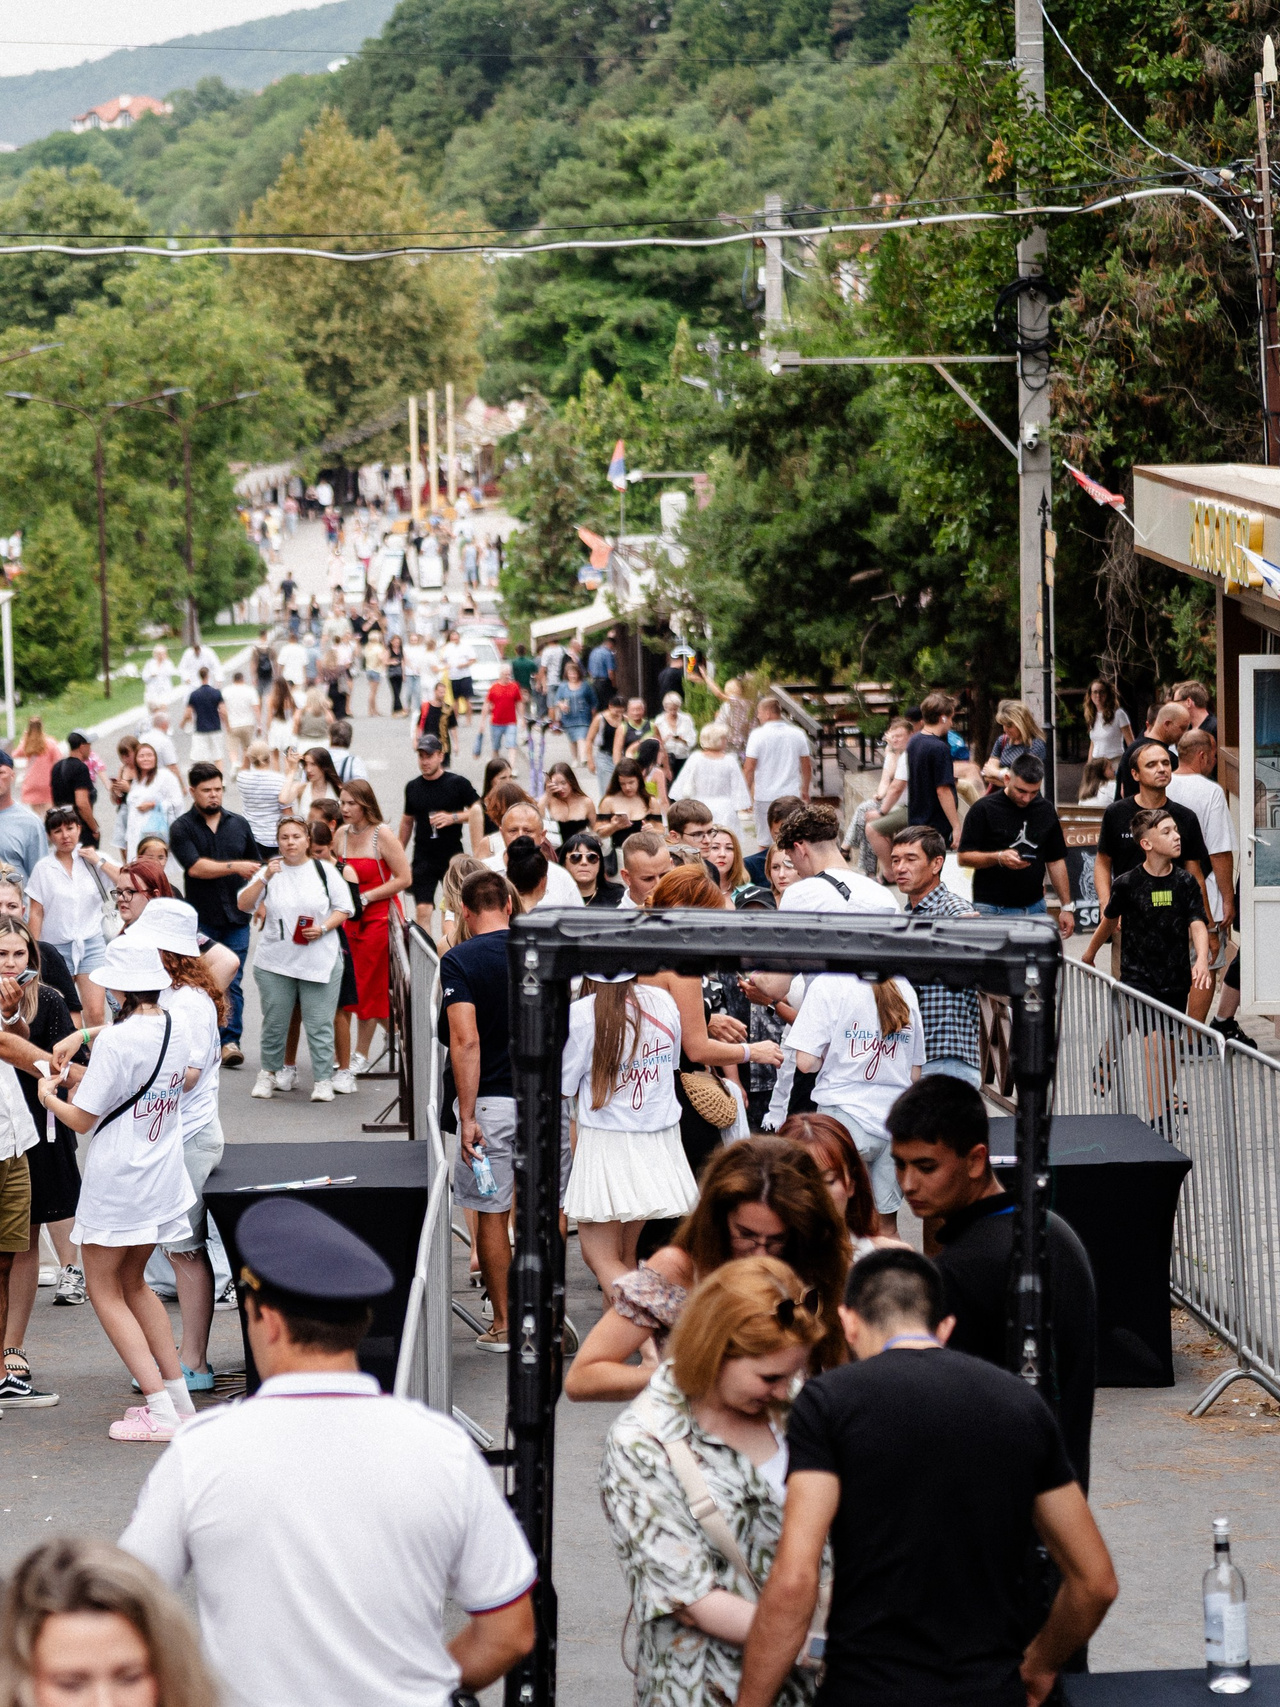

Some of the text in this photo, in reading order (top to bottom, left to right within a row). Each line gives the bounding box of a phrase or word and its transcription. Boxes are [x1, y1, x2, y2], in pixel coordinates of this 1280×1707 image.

[1066, 834, 1099, 845] COFF
[845, 1031, 874, 1040] БУДЬ
[642, 1054, 672, 1067] РИТМЕ
[614, 1038, 671, 1110] ight
[120, 1431, 151, 1440] crocs
